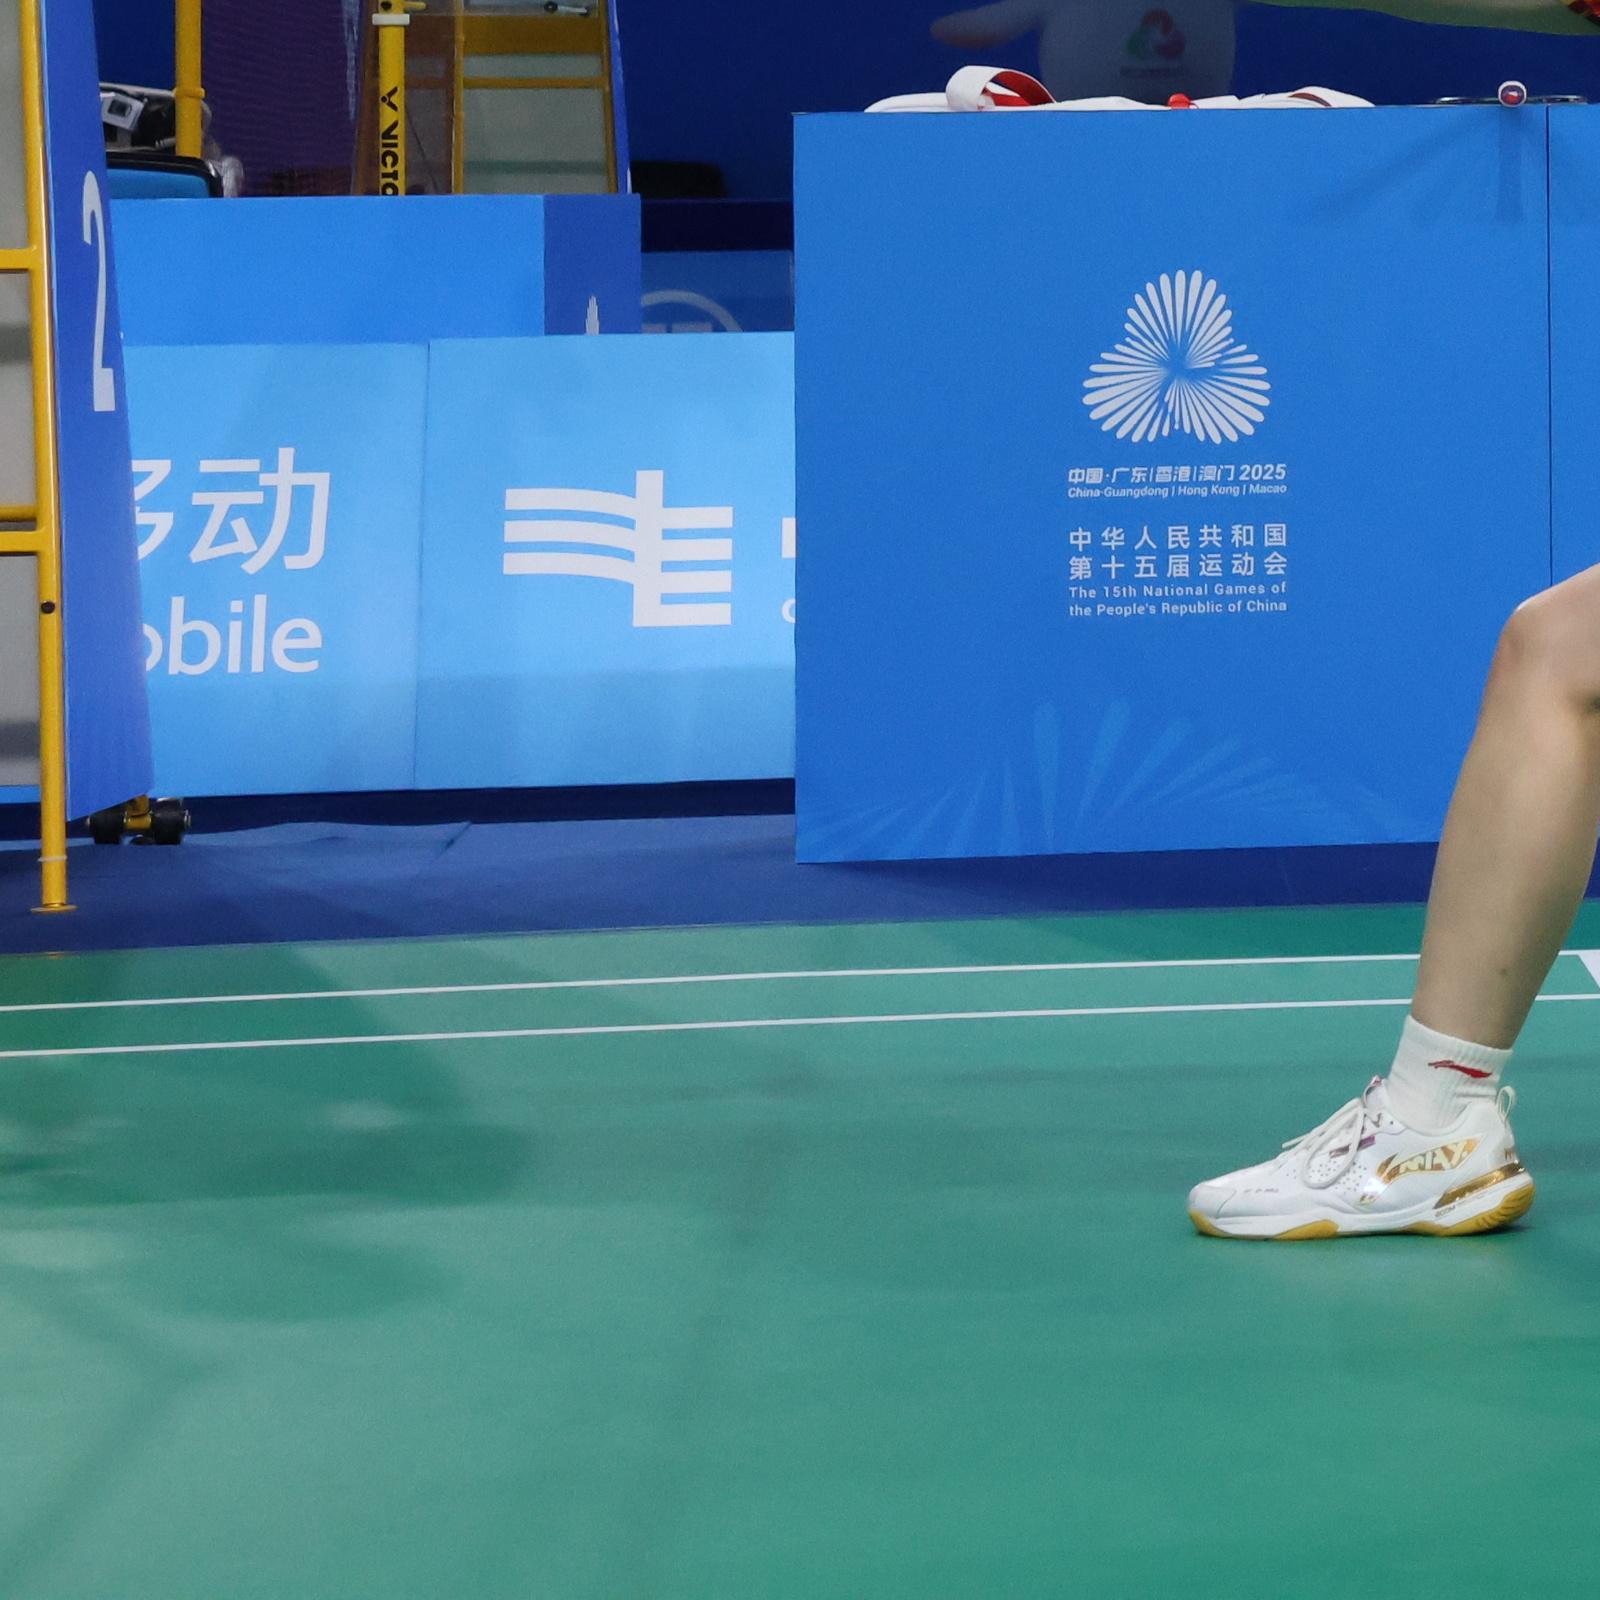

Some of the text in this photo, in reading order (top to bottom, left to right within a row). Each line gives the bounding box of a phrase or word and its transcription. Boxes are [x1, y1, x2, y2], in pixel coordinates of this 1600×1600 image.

[82, 170, 116, 413] 2
[1239, 463, 1287, 481] 2025
[1178, 484, 1208, 497] Hong
[1211, 483, 1240, 496] Kong
[1249, 482, 1287, 495] Macao
[1068, 523, 1287, 552] 中华人民共和国
[1068, 551, 1287, 580] 第十五届运动会
[1069, 581, 1287, 599] The 15th National Games of
[1069, 599, 1288, 618] the People's Republic of China
